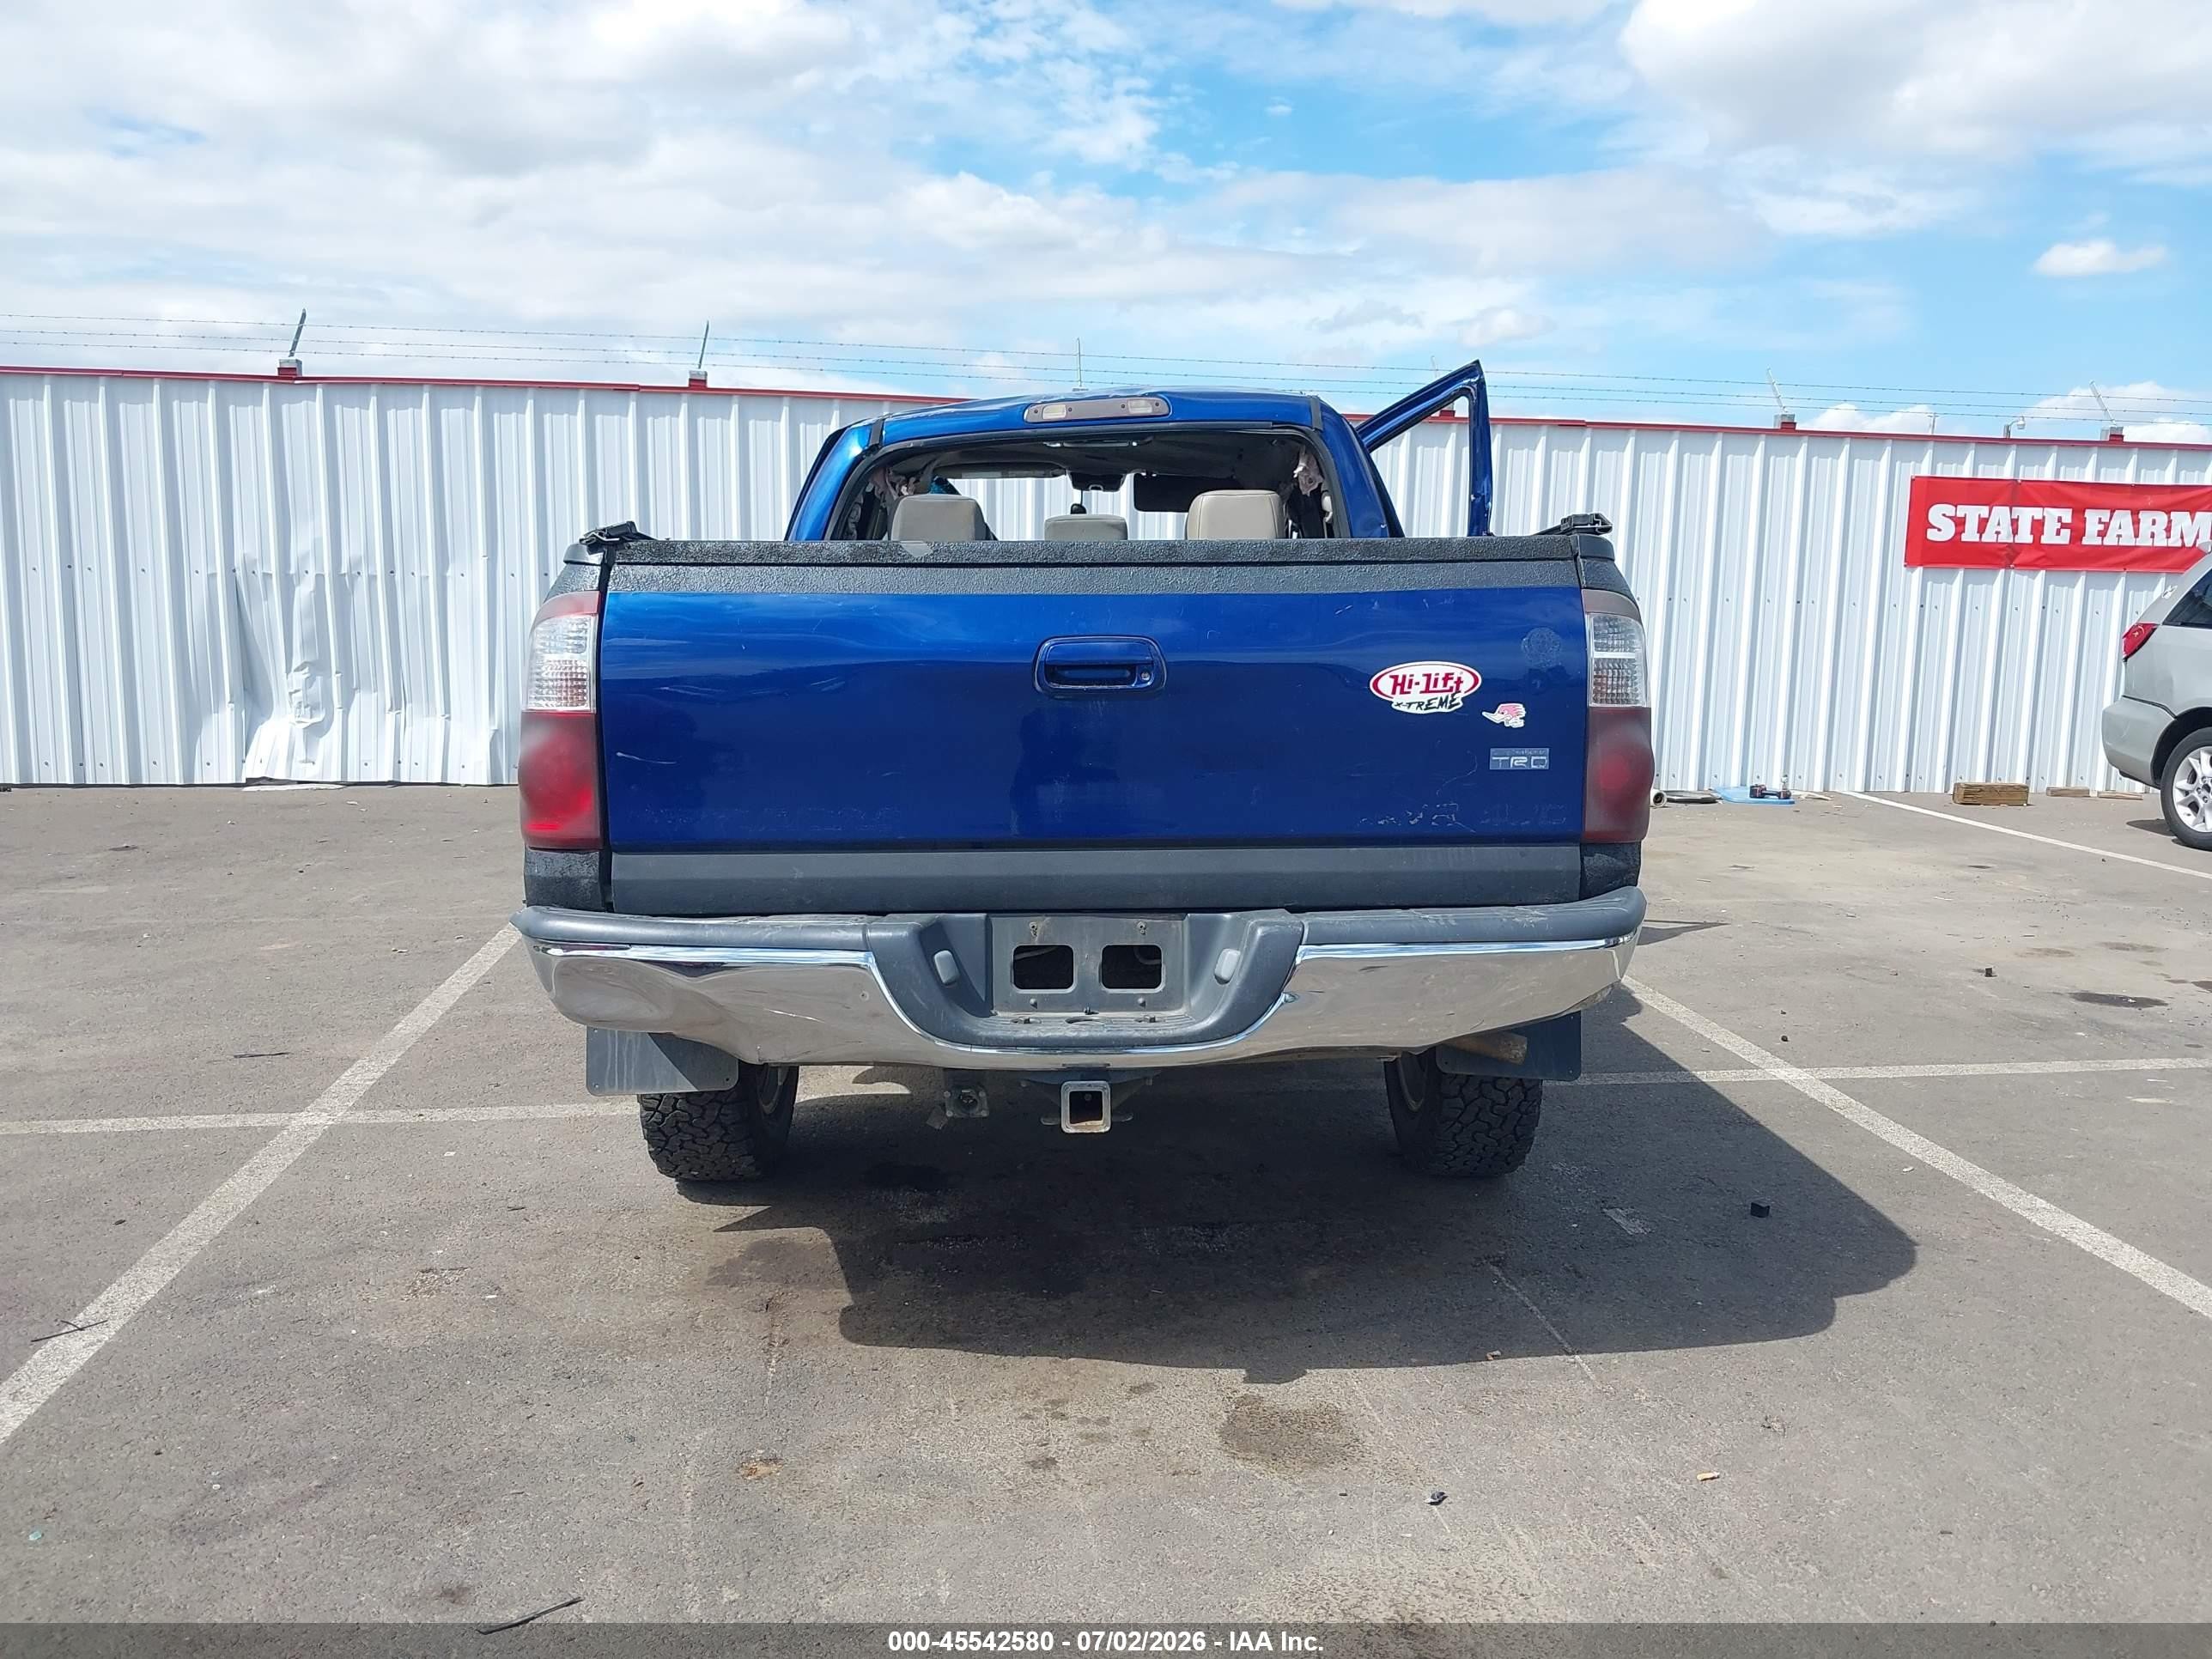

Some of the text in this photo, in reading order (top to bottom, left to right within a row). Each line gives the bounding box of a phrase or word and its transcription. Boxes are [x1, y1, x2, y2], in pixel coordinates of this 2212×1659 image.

[1926, 503, 2212, 548] STATE FARM
[1389, 672, 1463, 695] Hi-Lift
[1492, 757, 1547, 769] TRD
